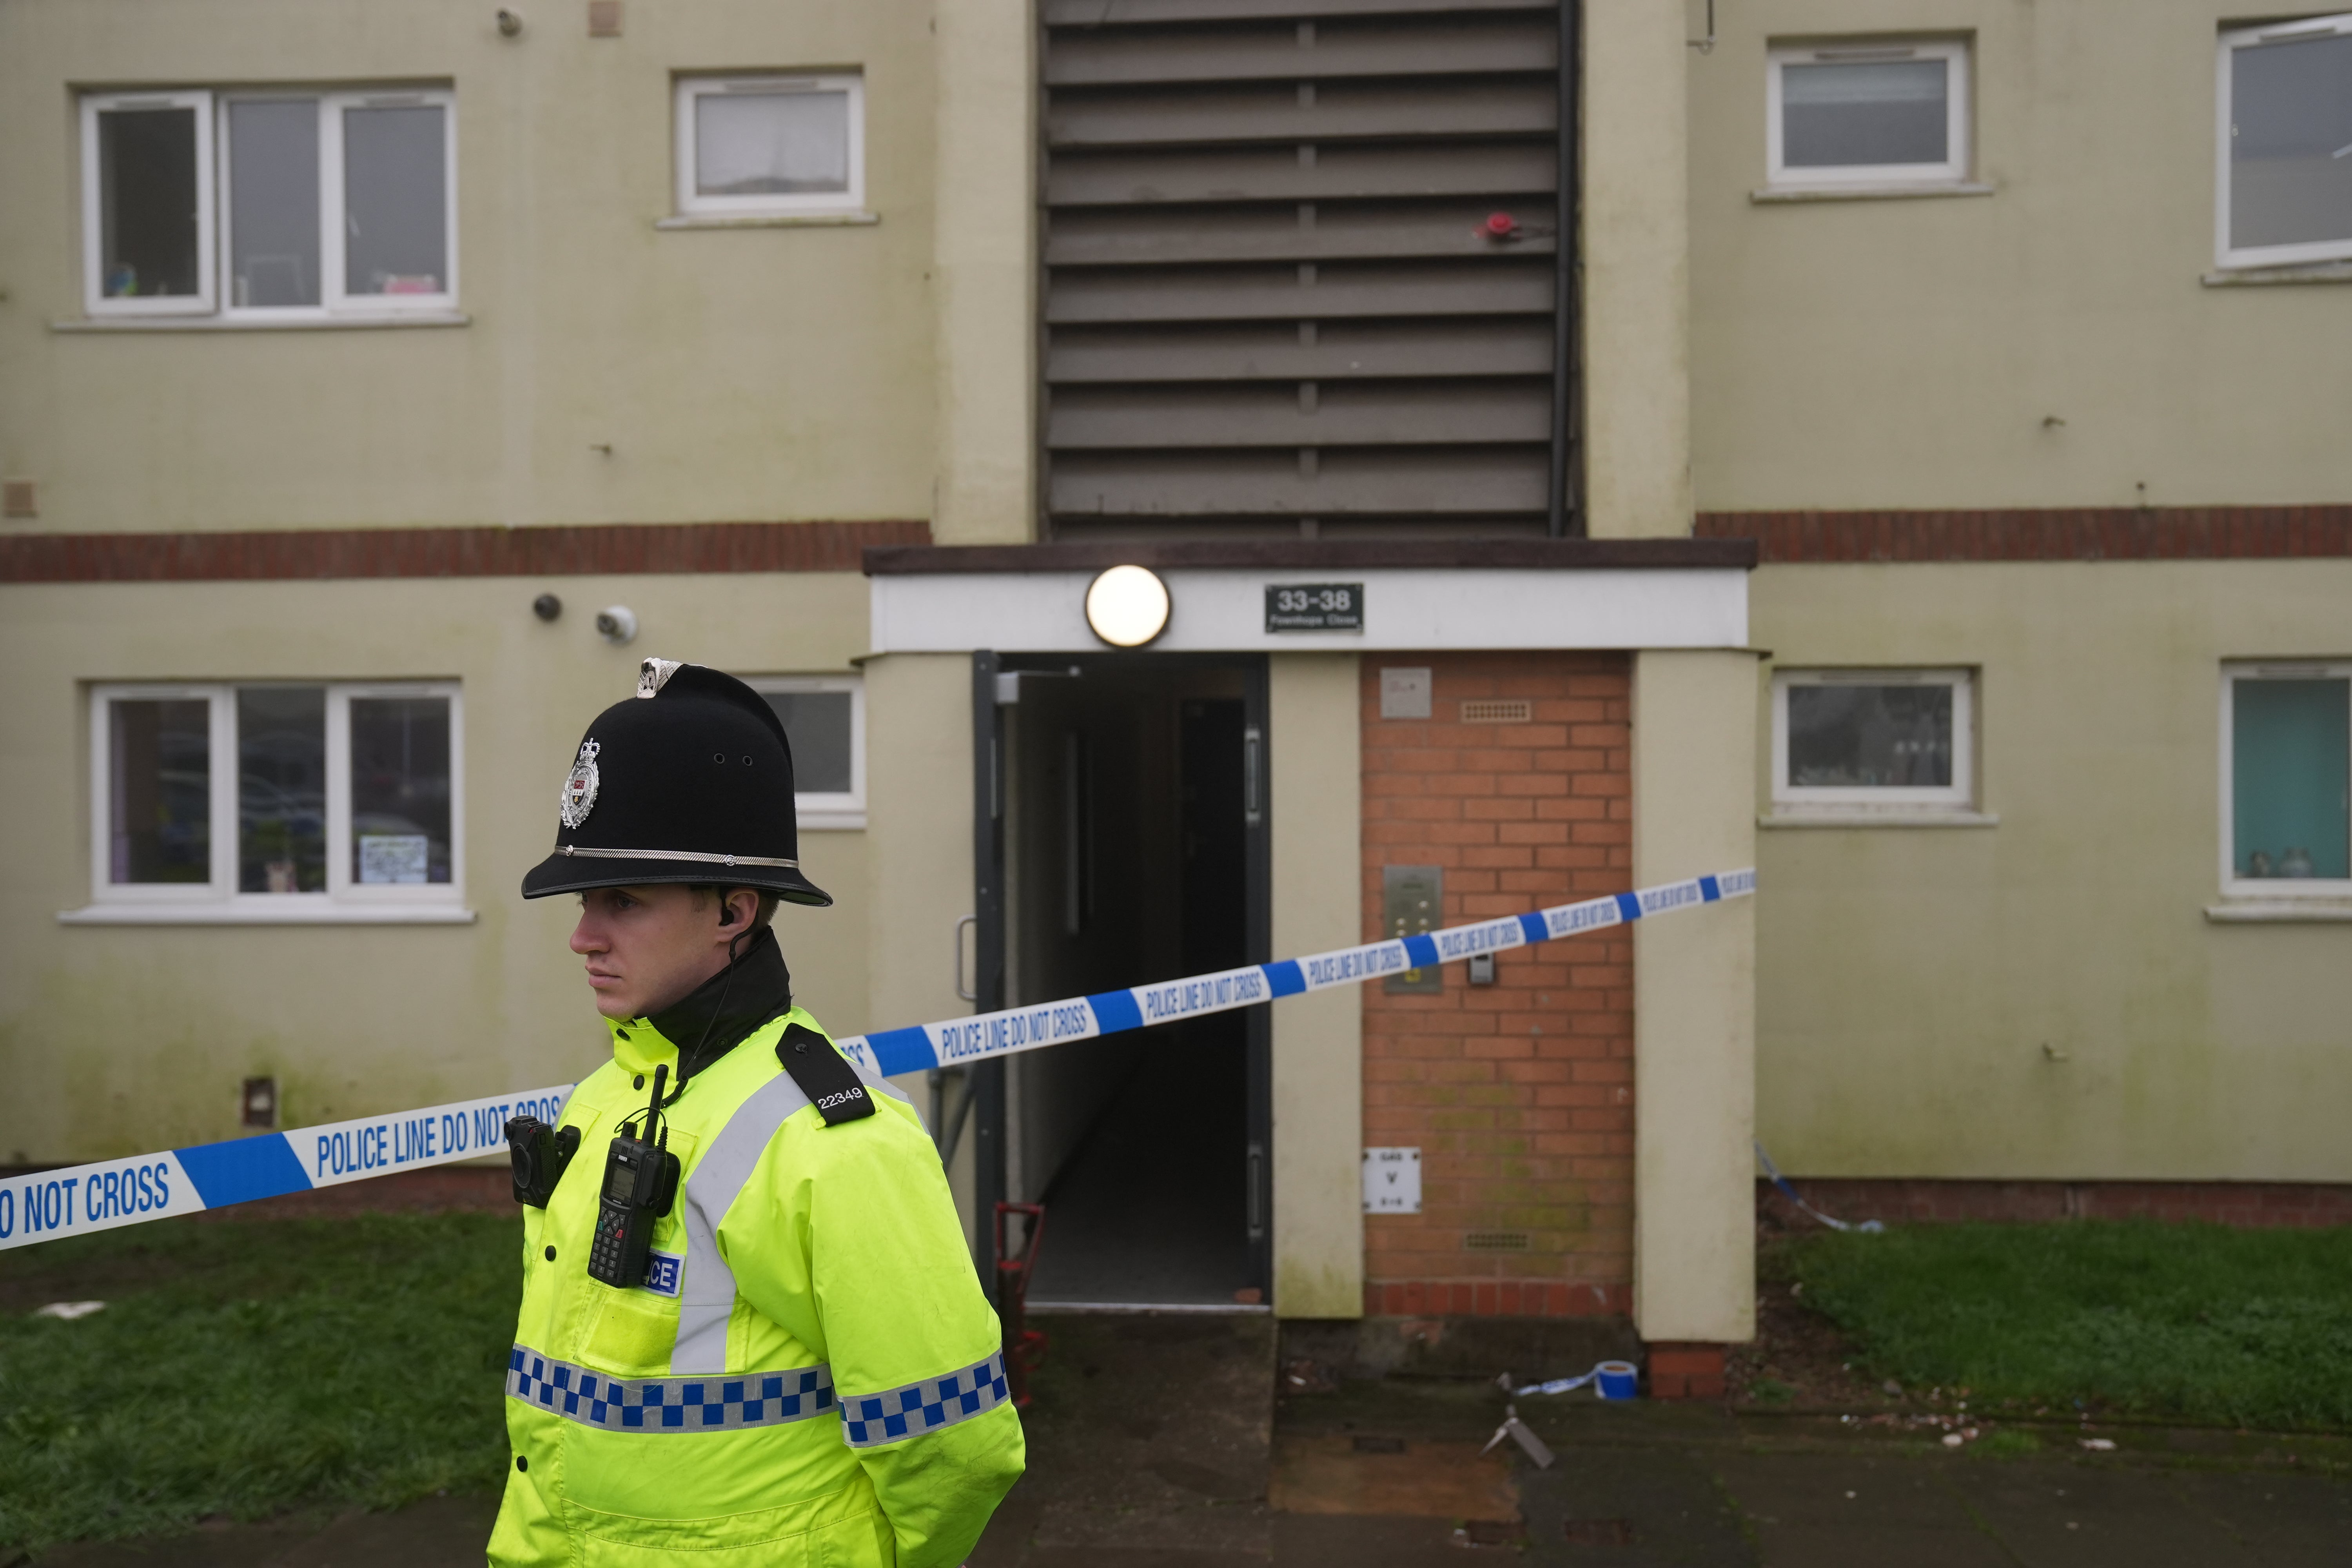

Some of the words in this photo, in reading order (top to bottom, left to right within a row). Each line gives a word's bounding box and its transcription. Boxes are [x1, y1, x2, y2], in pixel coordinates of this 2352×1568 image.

[1277, 589, 1352, 612] 33-38
[1146, 987, 1176, 1019] POLICE
[1178, 983, 1198, 1012] LINE
[1201, 980, 1214, 1008] DO
[943, 1023, 980, 1059] POLICE
[984, 1018, 1008, 1051] LINE
[1011, 1015, 1026, 1046] DO
[1029, 1010, 1049, 1043] NOT
[1053, 1004, 1087, 1038] CROSS
[818, 1087, 862, 1109] 22349
[318, 1125, 387, 1178] POLICE
[394, 1117, 436, 1163] LINE
[442, 1111, 468, 1154] DO
[474, 1105, 509, 1149] NOT
[0, 1189, 14, 1239] O
[24, 1178, 78, 1234] NOT
[86, 1162, 169, 1222] CROSS
